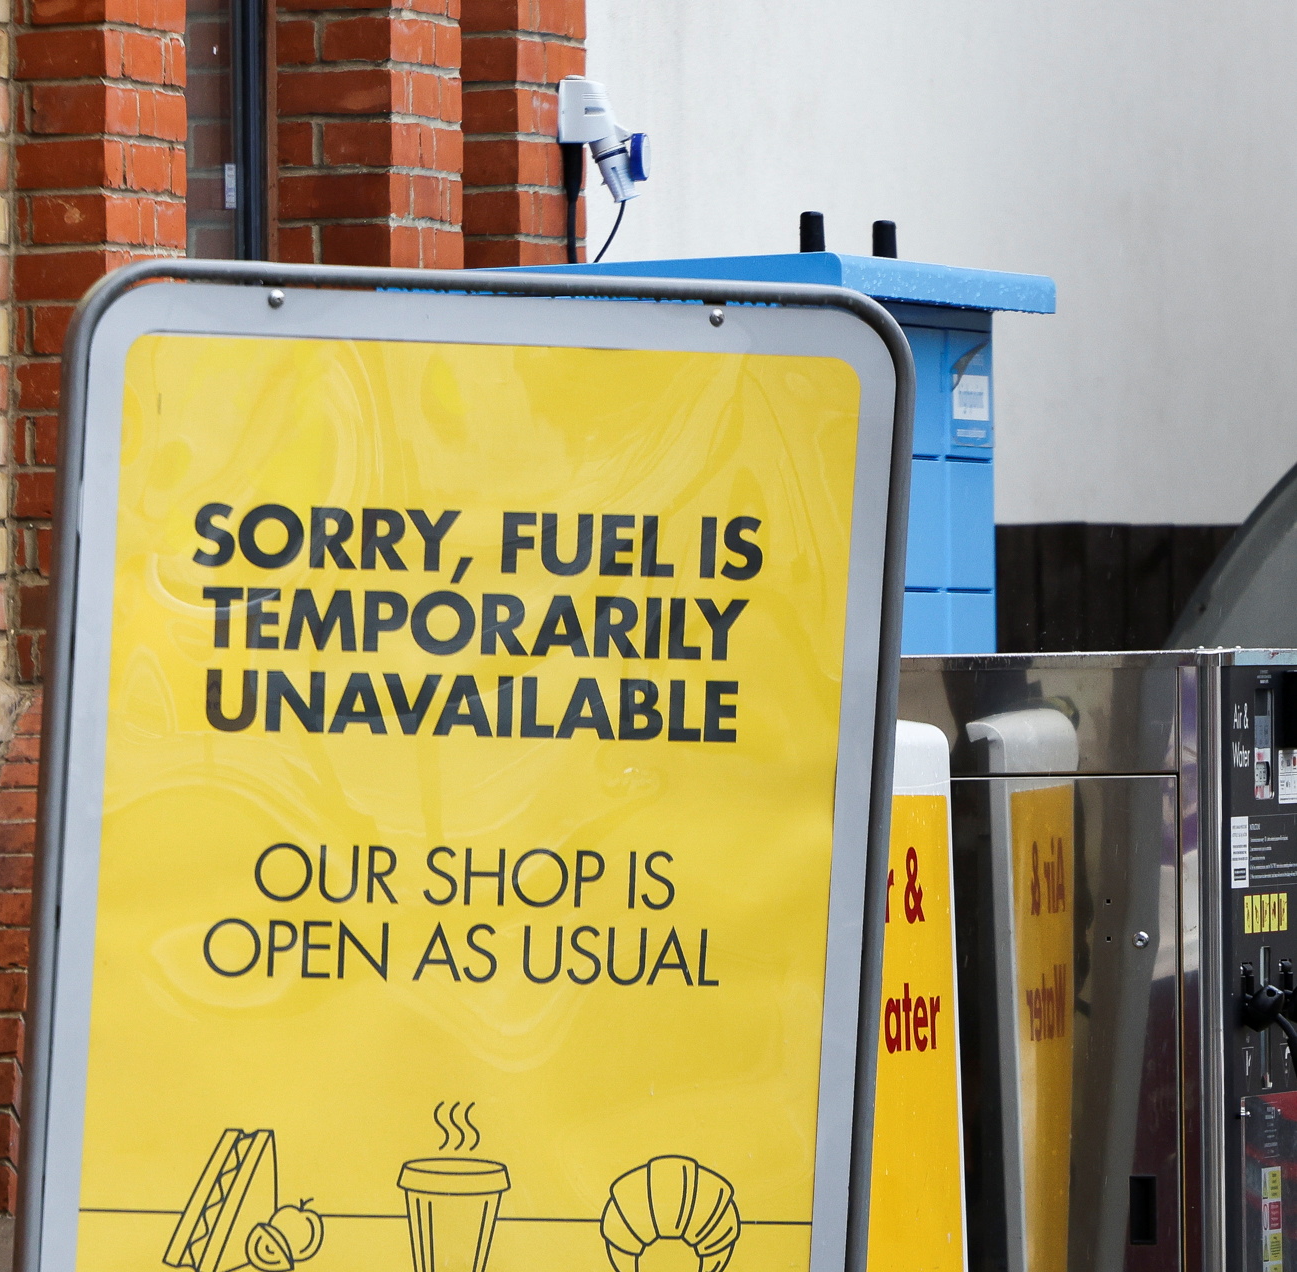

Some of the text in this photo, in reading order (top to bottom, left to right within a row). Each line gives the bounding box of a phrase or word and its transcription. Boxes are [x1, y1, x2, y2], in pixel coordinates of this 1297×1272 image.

[193, 503, 763, 583] SORRY, FUEL IS
[203, 587, 749, 661] TEMPORARILY
[206, 669, 739, 743] UNAVAILABLE
[1232, 741, 1250, 768] Water
[255, 843, 675, 911] OUR SHOP IS
[903, 846, 926, 925] &
[203, 918, 720, 987] OPEN AS USUAL
[884, 982, 941, 1055] ater
